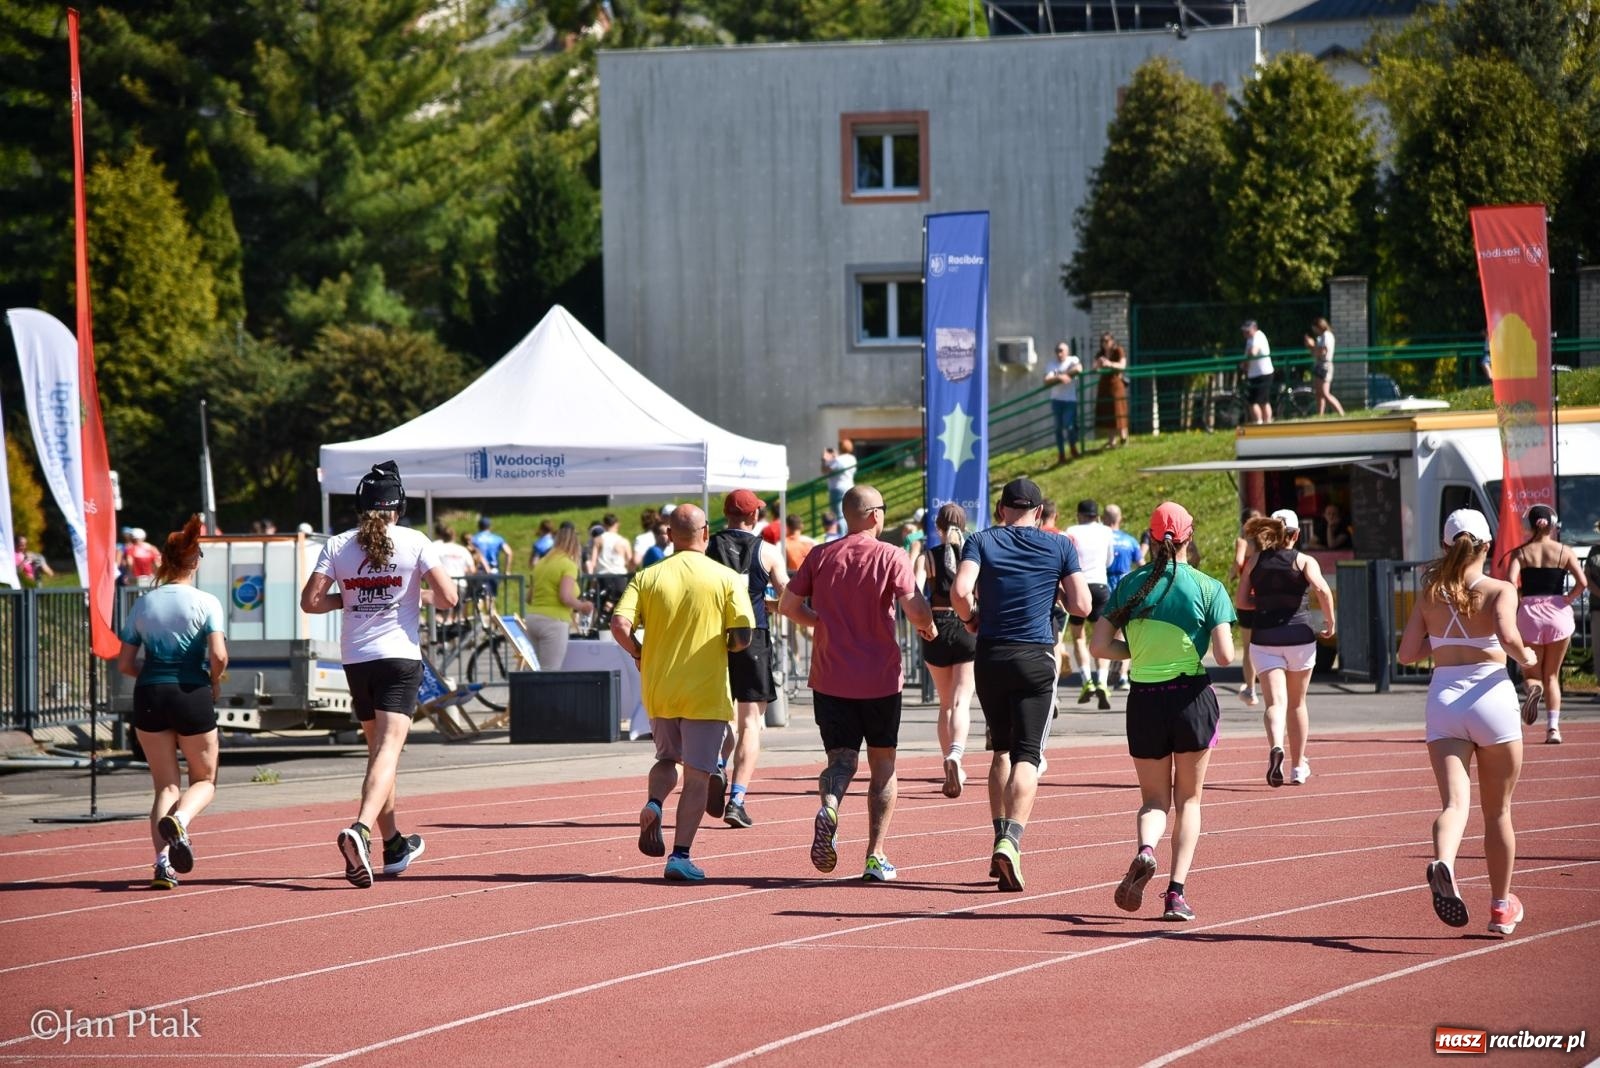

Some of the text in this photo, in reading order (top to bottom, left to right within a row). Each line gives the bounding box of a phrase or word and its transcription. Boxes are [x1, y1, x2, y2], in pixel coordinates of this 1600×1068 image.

[494, 453, 565, 468] Wodociągi
[495, 468, 566, 479] Raciborskie
[358, 587, 393, 603] HILL
